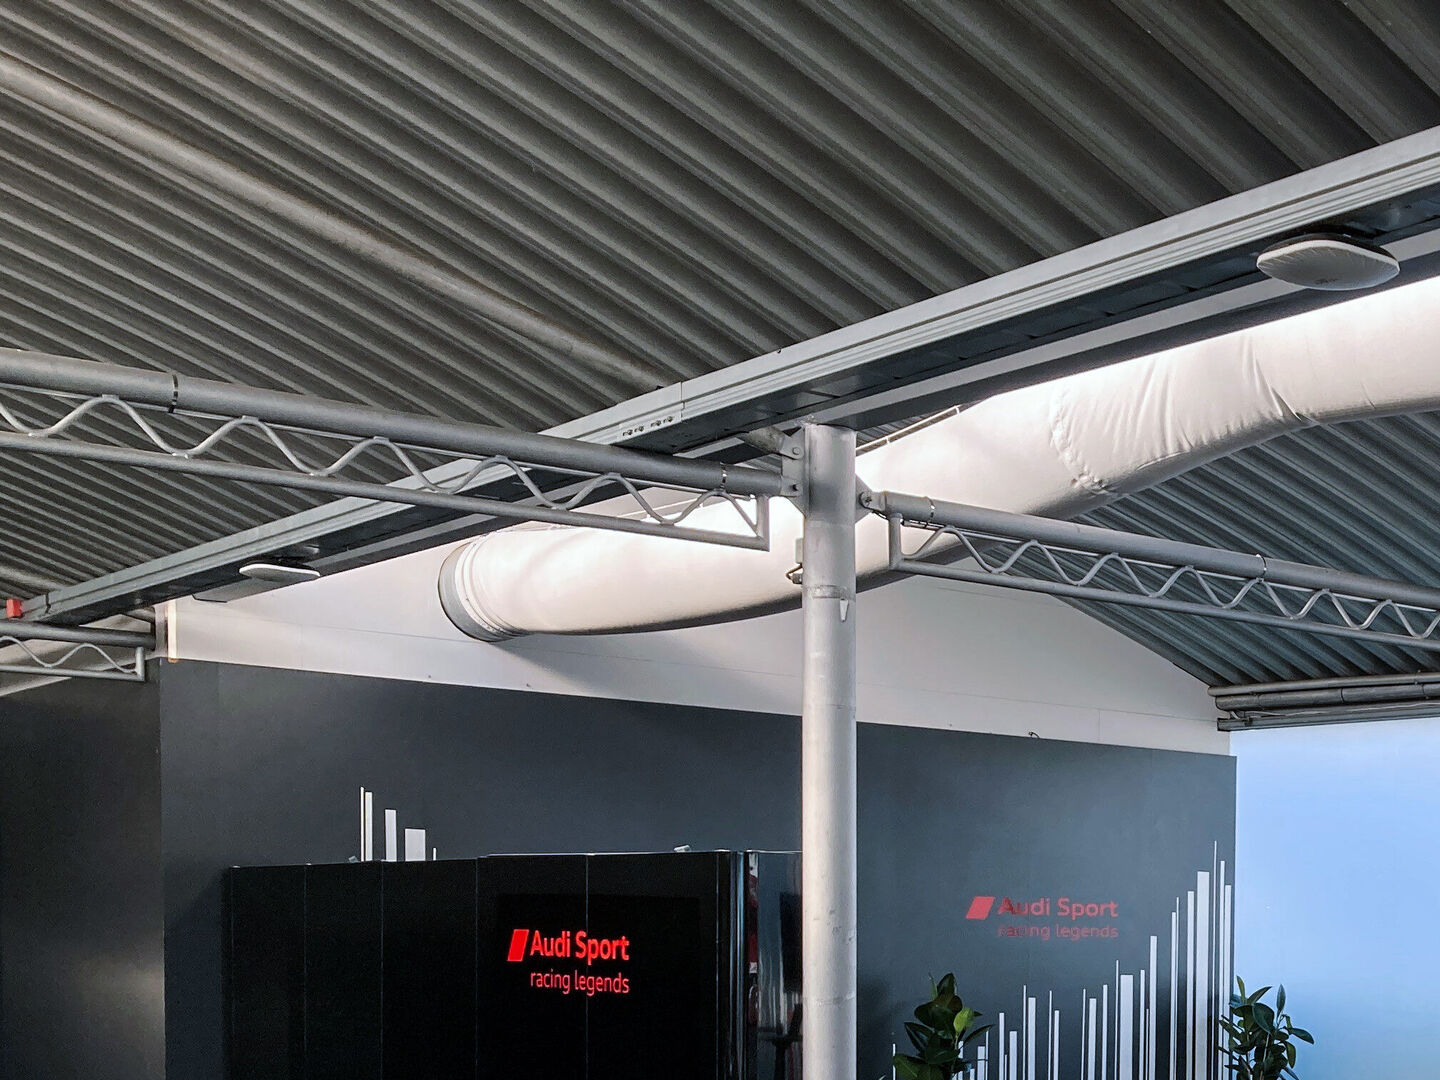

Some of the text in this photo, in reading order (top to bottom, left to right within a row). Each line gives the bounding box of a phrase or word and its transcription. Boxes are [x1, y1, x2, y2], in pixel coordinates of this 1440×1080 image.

[998, 897, 1119, 920] Audi Sport
[998, 924, 1119, 941] racing legends
[530, 930, 629, 965] Audi Sport
[530, 968, 630, 997] racing legends
